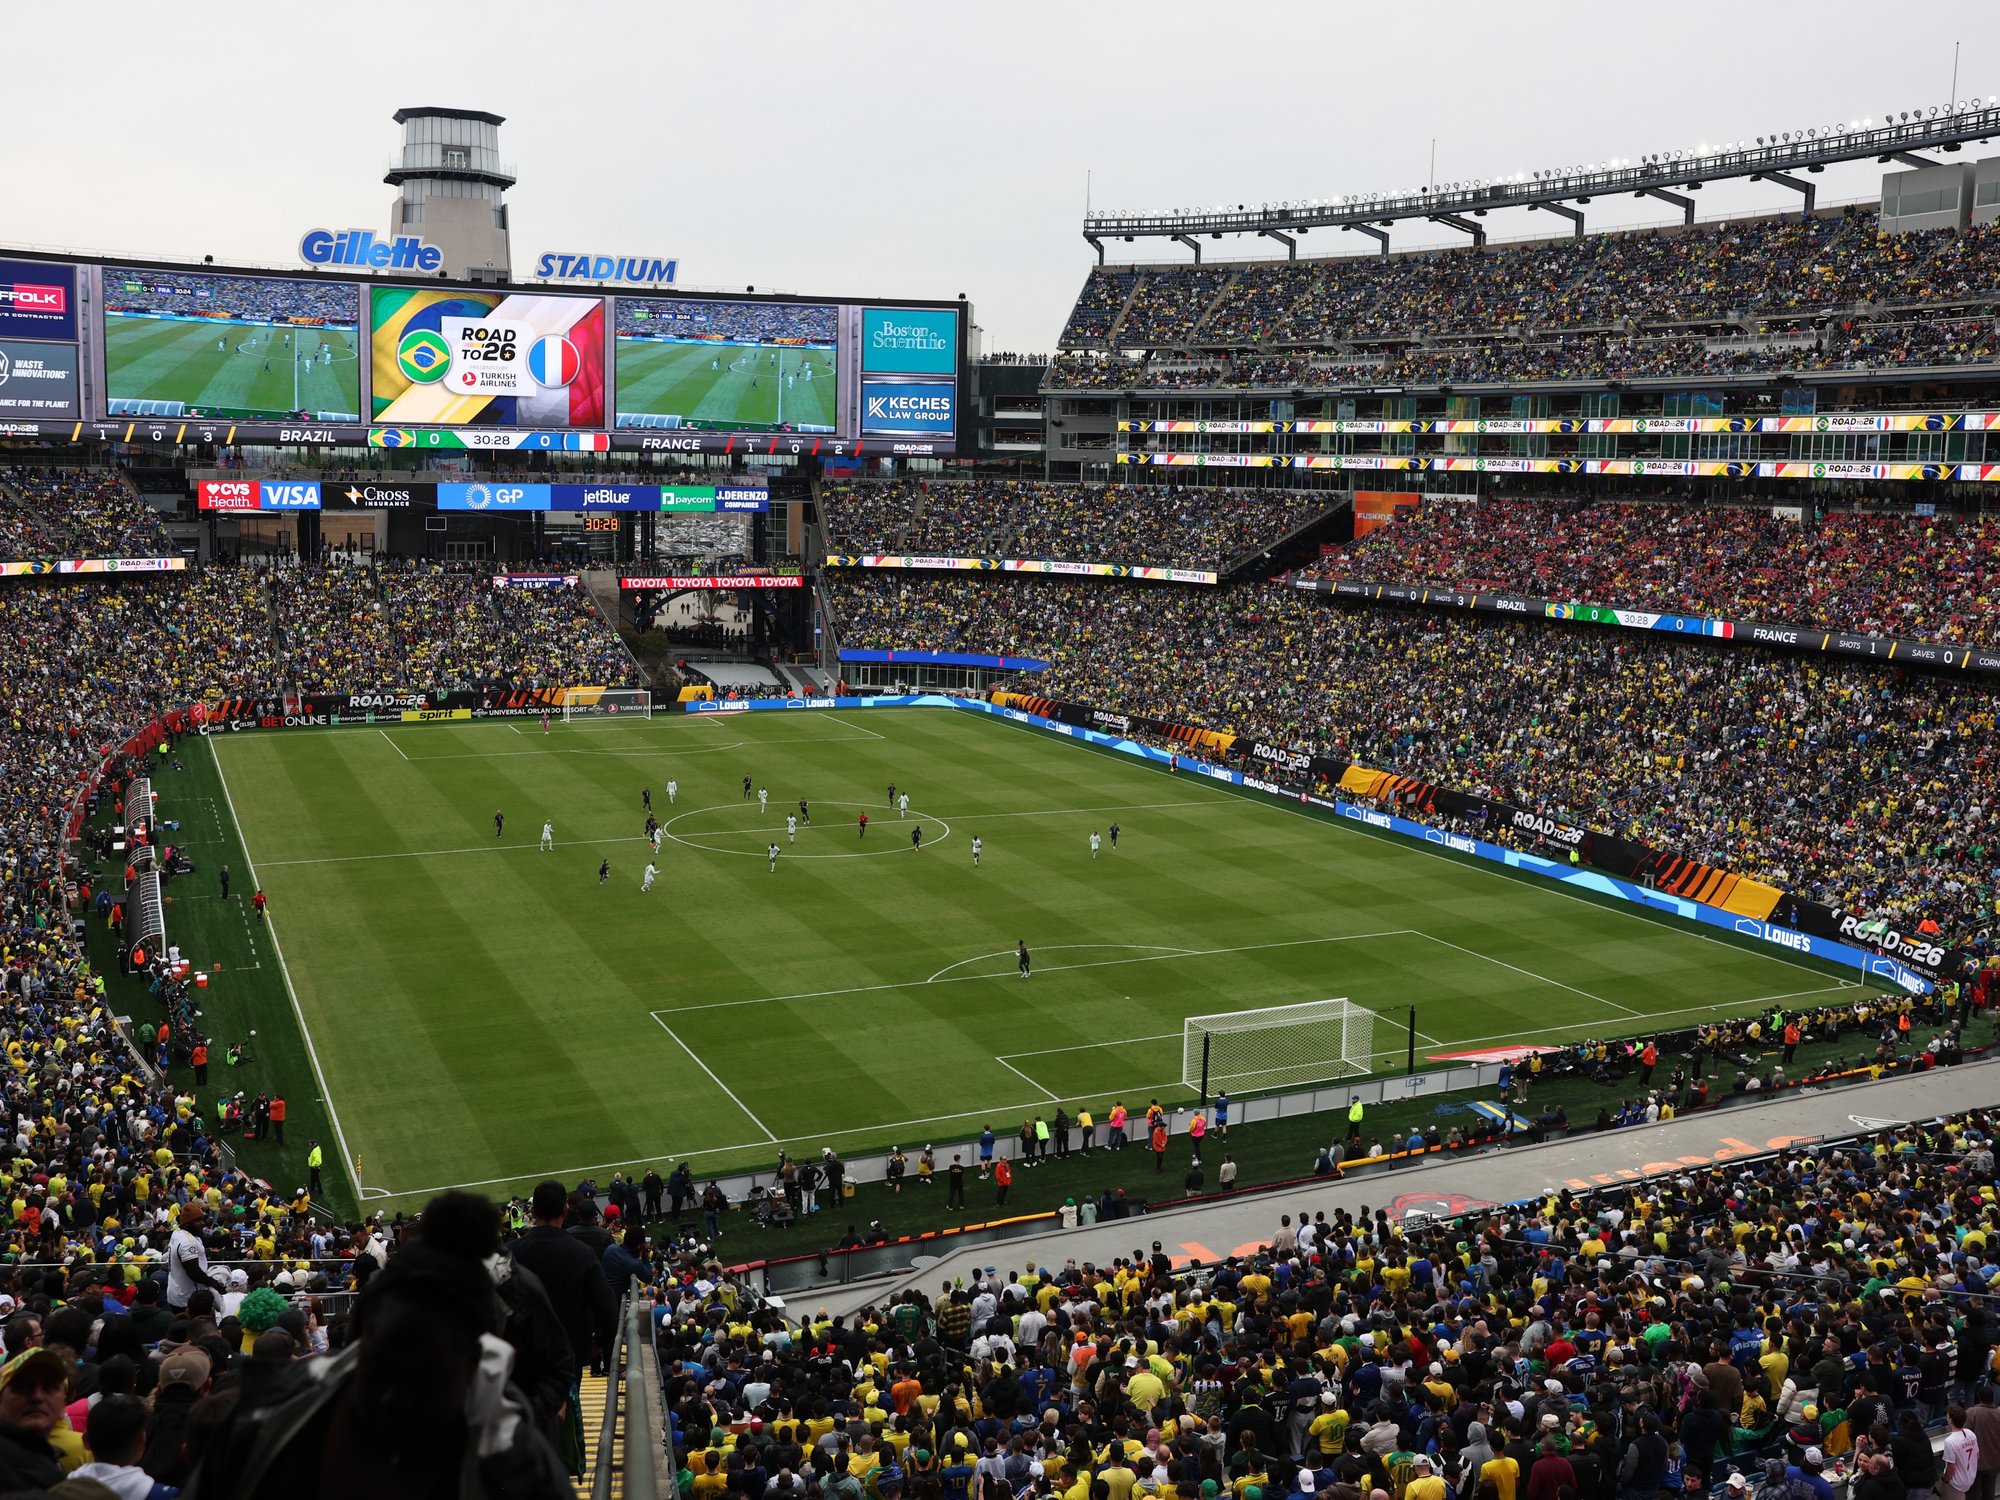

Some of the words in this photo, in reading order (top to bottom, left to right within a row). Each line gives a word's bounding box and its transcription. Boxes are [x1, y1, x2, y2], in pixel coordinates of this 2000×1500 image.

[302, 230, 442, 273] Gillette
[536, 254, 676, 284] STADIUM
[462, 327, 516, 342] ROAD
[882, 321, 929, 337] Boston
[872, 330, 946, 350] Scientific
[462, 349, 482, 360] TO
[15, 359, 44, 369] WASTE
[480, 372, 516, 380] TURKISH
[480, 380, 517, 388] AIRLINES
[889, 397, 950, 410] KECHES
[889, 411, 912, 419] LAW
[914, 412, 950, 421] GROUP
[100, 429, 106, 440] 1
[152, 430, 162, 441] 0
[204, 431, 213, 442] 3
[279, 430, 336, 443] BRAZIL
[430, 433, 440, 444] 0
[473, 435, 510, 446] 30:28
[540, 435, 550, 447] 0
[642, 438, 701, 450] FRANCE
[748, 443, 753, 453] 1
[791, 444, 800, 453] 0
[835, 445, 843, 454] 2
[220, 483, 250, 495] CVS
[262, 486, 319, 505] VISA
[583, 489, 629, 506] jetBlue
[675, 496, 712, 505] paycom
[585, 518, 618, 530] 30:28
[626, 578, 668, 588] TOYOTA
[672, 578, 713, 588] TOYOTA
[716, 577, 756, 587] TOYOTA
[760, 577, 799, 587] TOYOTA
[1364, 587, 1369, 596] 1
[1410, 591, 1417, 601] 0
[1457, 596, 1464, 606] 3
[1496, 600, 1527, 612] BRAZIL
[1591, 609, 1598, 620] 0
[1624, 614, 1649, 625] 30:28
[1676, 619, 1684, 630] 0
[1753, 628, 1798, 644] FRANCE
[1839, 640, 1861, 650] SHOTS
[1870, 642, 1876, 654] 1
[1912, 649, 1935, 659] SAVES
[1943, 650, 1953, 664] 0
[349, 695, 393, 707] ROAD
[419, 710, 454, 721] spirit
[527, 707, 561, 715] ORLANDO
[1093, 711, 1114, 722] ROAD
[262, 714, 327, 728] BETONLINE
[1253, 743, 1287, 762] ROAD
[1295, 753, 1311, 769] 26
[1211, 765, 1233, 783] LOWE'S
[1243, 776, 1265, 790] ROAD
[1270, 784, 1279, 794] 26
[1363, 809, 1391, 829] LOWE'S
[1514, 811, 1555, 835] ROAD
[1553, 828, 1565, 840] TO
[1563, 827, 1585, 844] 26
[1445, 832, 1476, 854] LOWE'S
[1764, 922, 1811, 953] LOWE'S
[1899, 942, 1914, 957] TO
[1912, 943, 1945, 967] 26
[1911, 964, 1938, 980] AIRLINES
[1588, 1340, 1601, 1352] 23
[1905, 1381, 1920, 1399] 10
[1329, 1423, 1343, 1441] 10
[1966, 1449, 1973, 1470] 7
